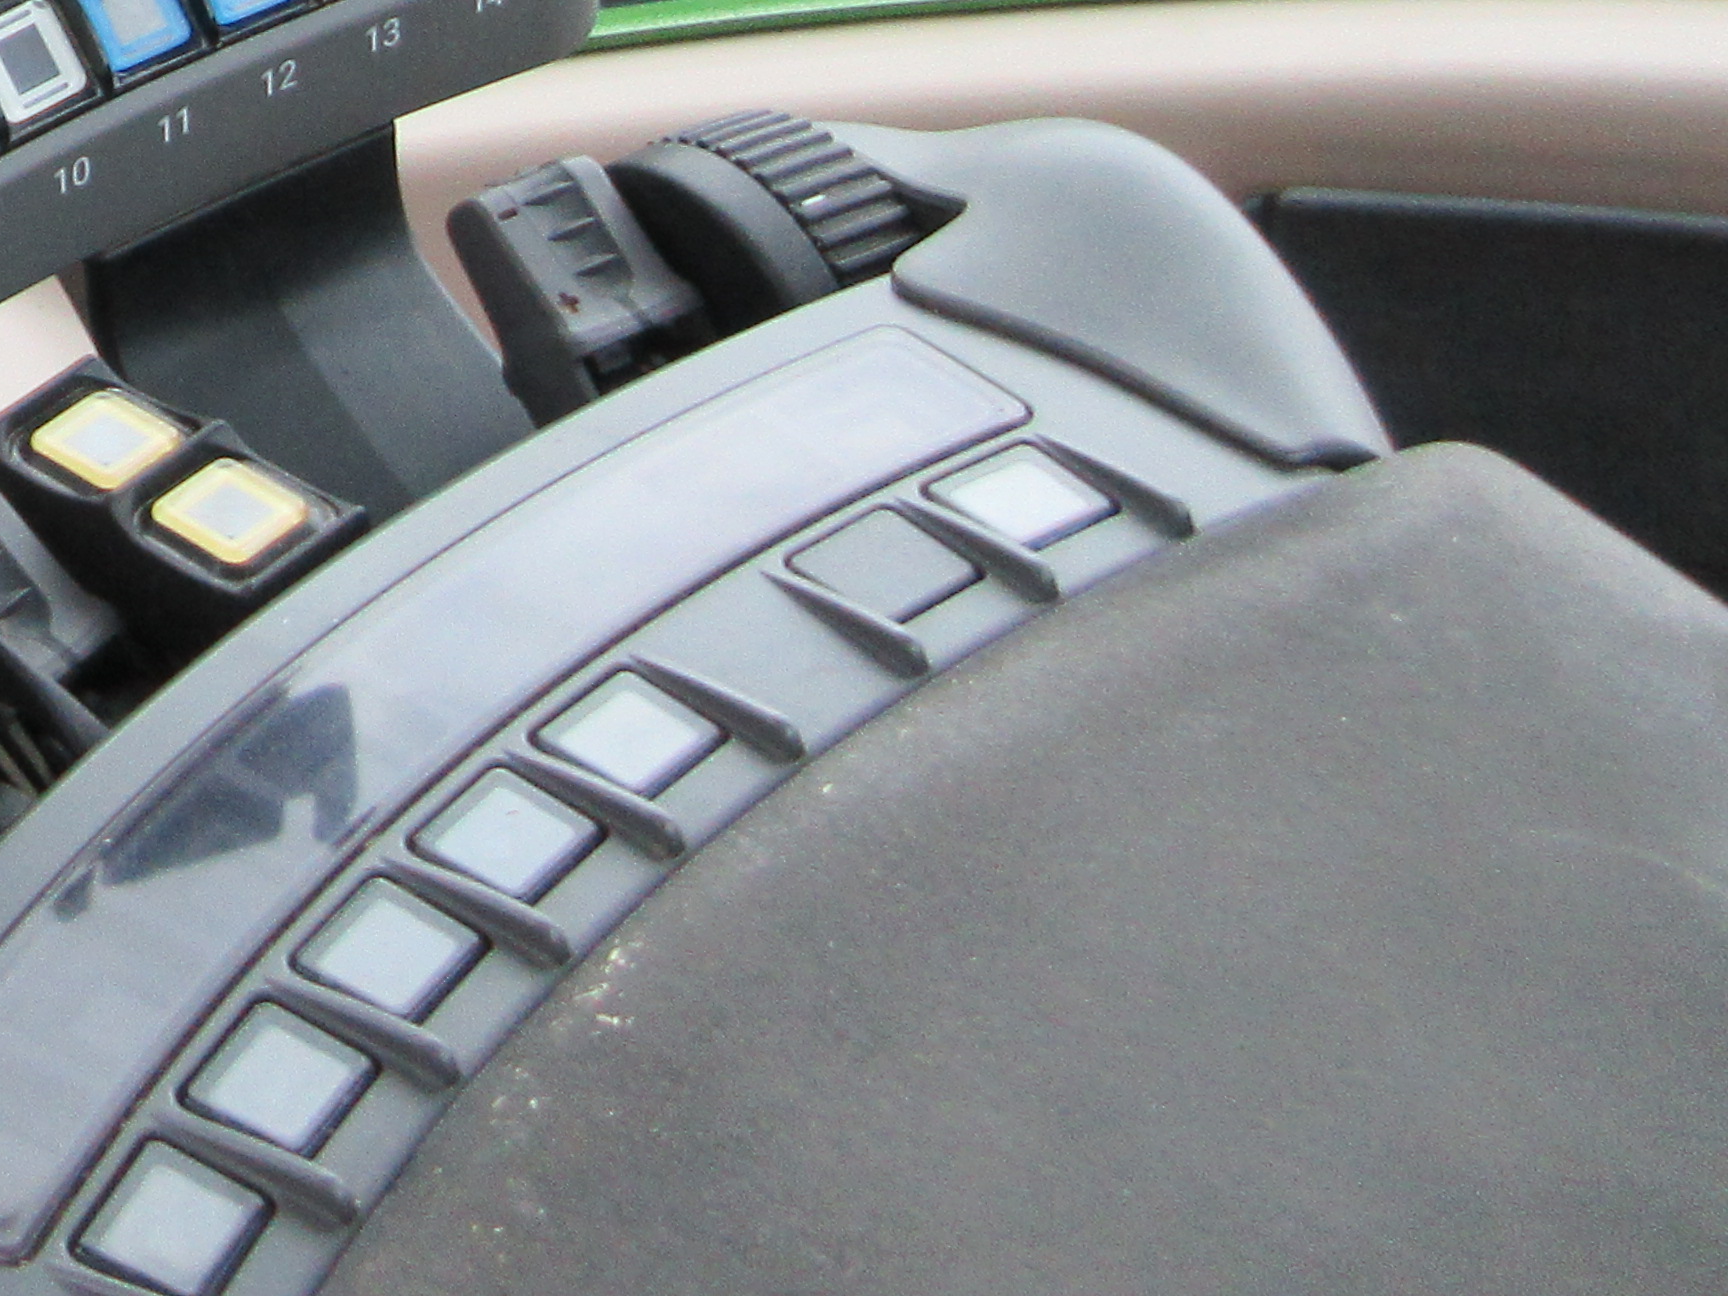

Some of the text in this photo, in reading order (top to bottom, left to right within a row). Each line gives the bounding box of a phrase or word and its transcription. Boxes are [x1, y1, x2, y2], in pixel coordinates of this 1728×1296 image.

[54, 155, 92, 195] 10
[158, 106, 190, 144] 11
[262, 58, 297, 97] 12
[367, 16, 402, 53] 13
